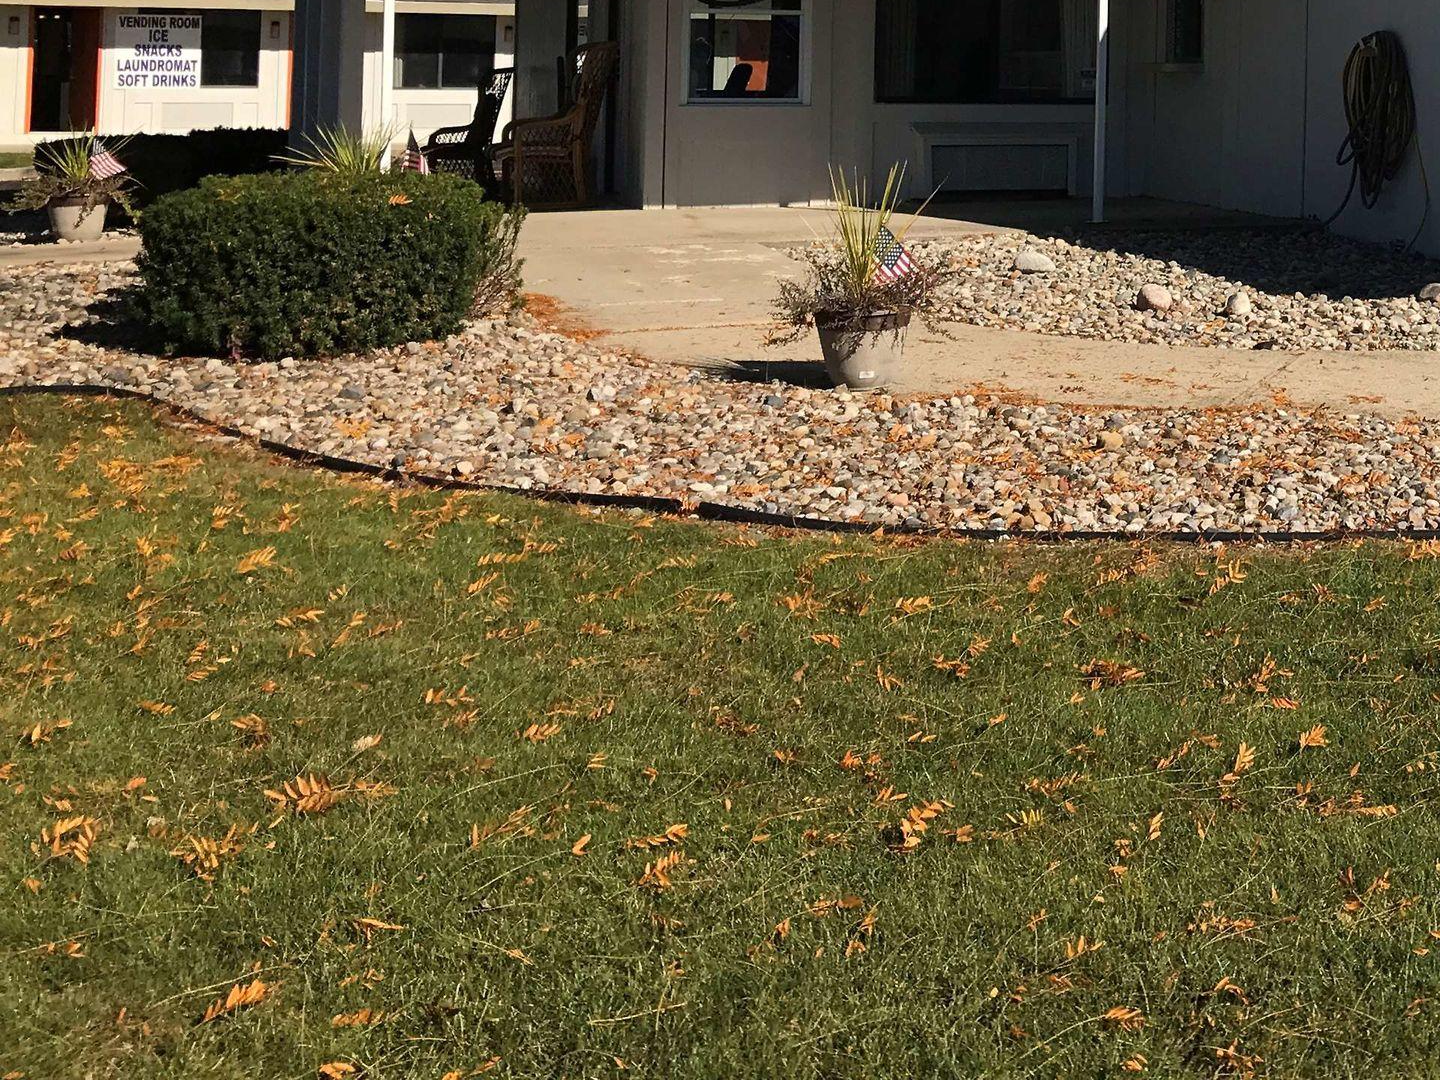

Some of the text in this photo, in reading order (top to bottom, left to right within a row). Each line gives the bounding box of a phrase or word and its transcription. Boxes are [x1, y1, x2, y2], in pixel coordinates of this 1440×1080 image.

[119, 16, 200, 29] VENDING ROOM
[148, 29, 169, 43] ICE
[134, 43, 182, 57] SNACKS
[117, 59, 198, 72] LAUNDROMAT
[118, 74, 196, 87] SOFT DRINKS
